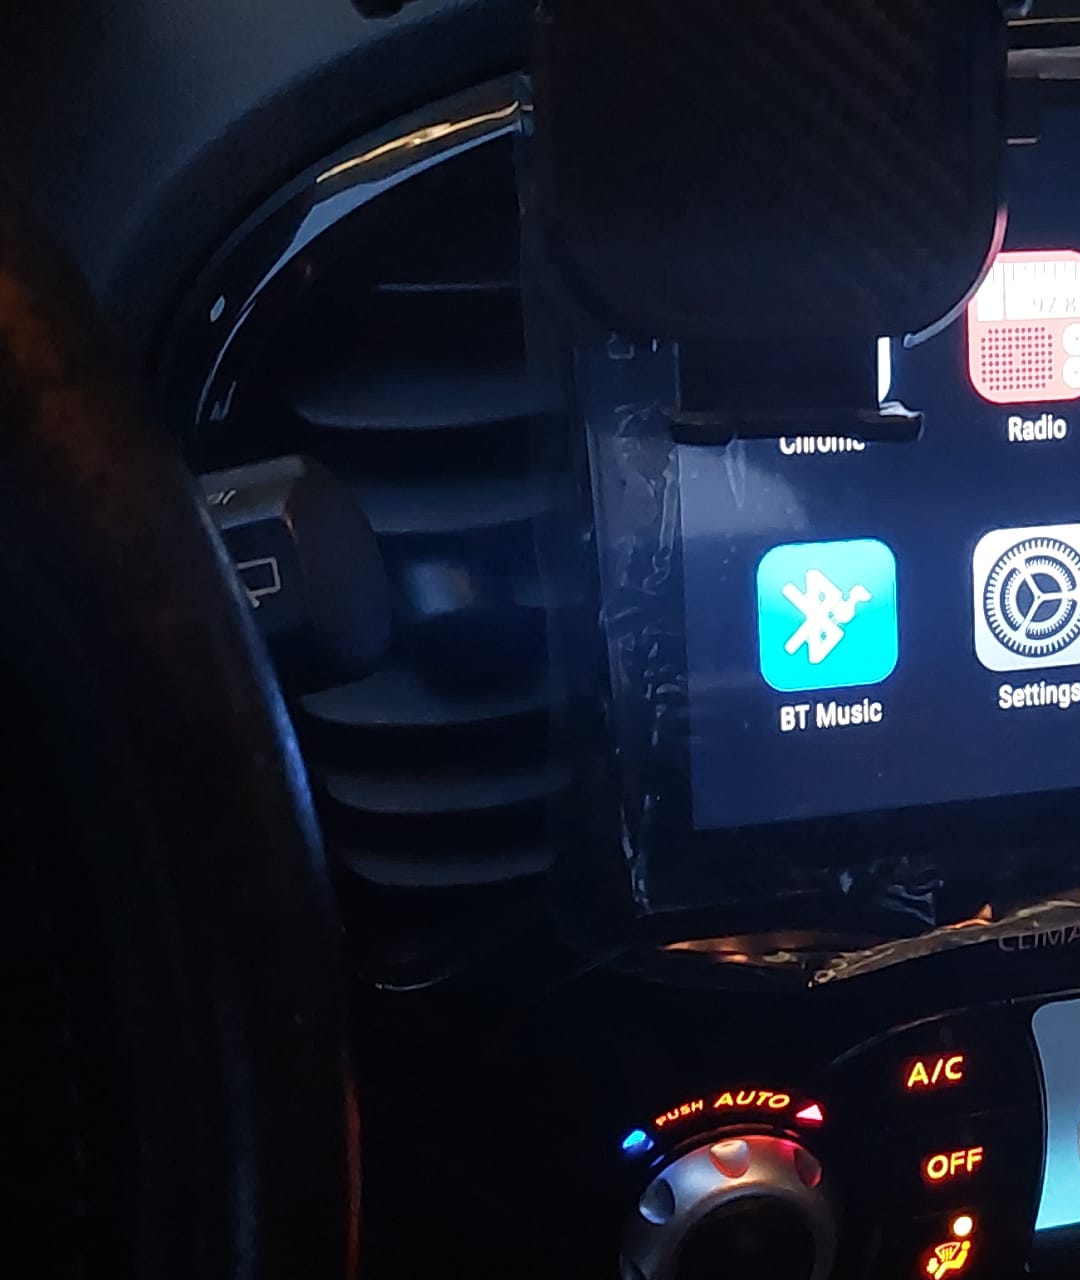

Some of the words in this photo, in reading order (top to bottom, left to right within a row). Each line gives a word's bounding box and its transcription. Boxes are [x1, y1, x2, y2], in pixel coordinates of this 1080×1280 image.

[1007, 413, 1067, 442] Radio
[780, 704, 810, 732] BT
[815, 698, 884, 727] Music
[907, 1056, 963, 1088] A/C
[655, 1100, 704, 1126] PUSH
[714, 1091, 790, 1108] AUTO
[926, 1147, 983, 1180] OFF
